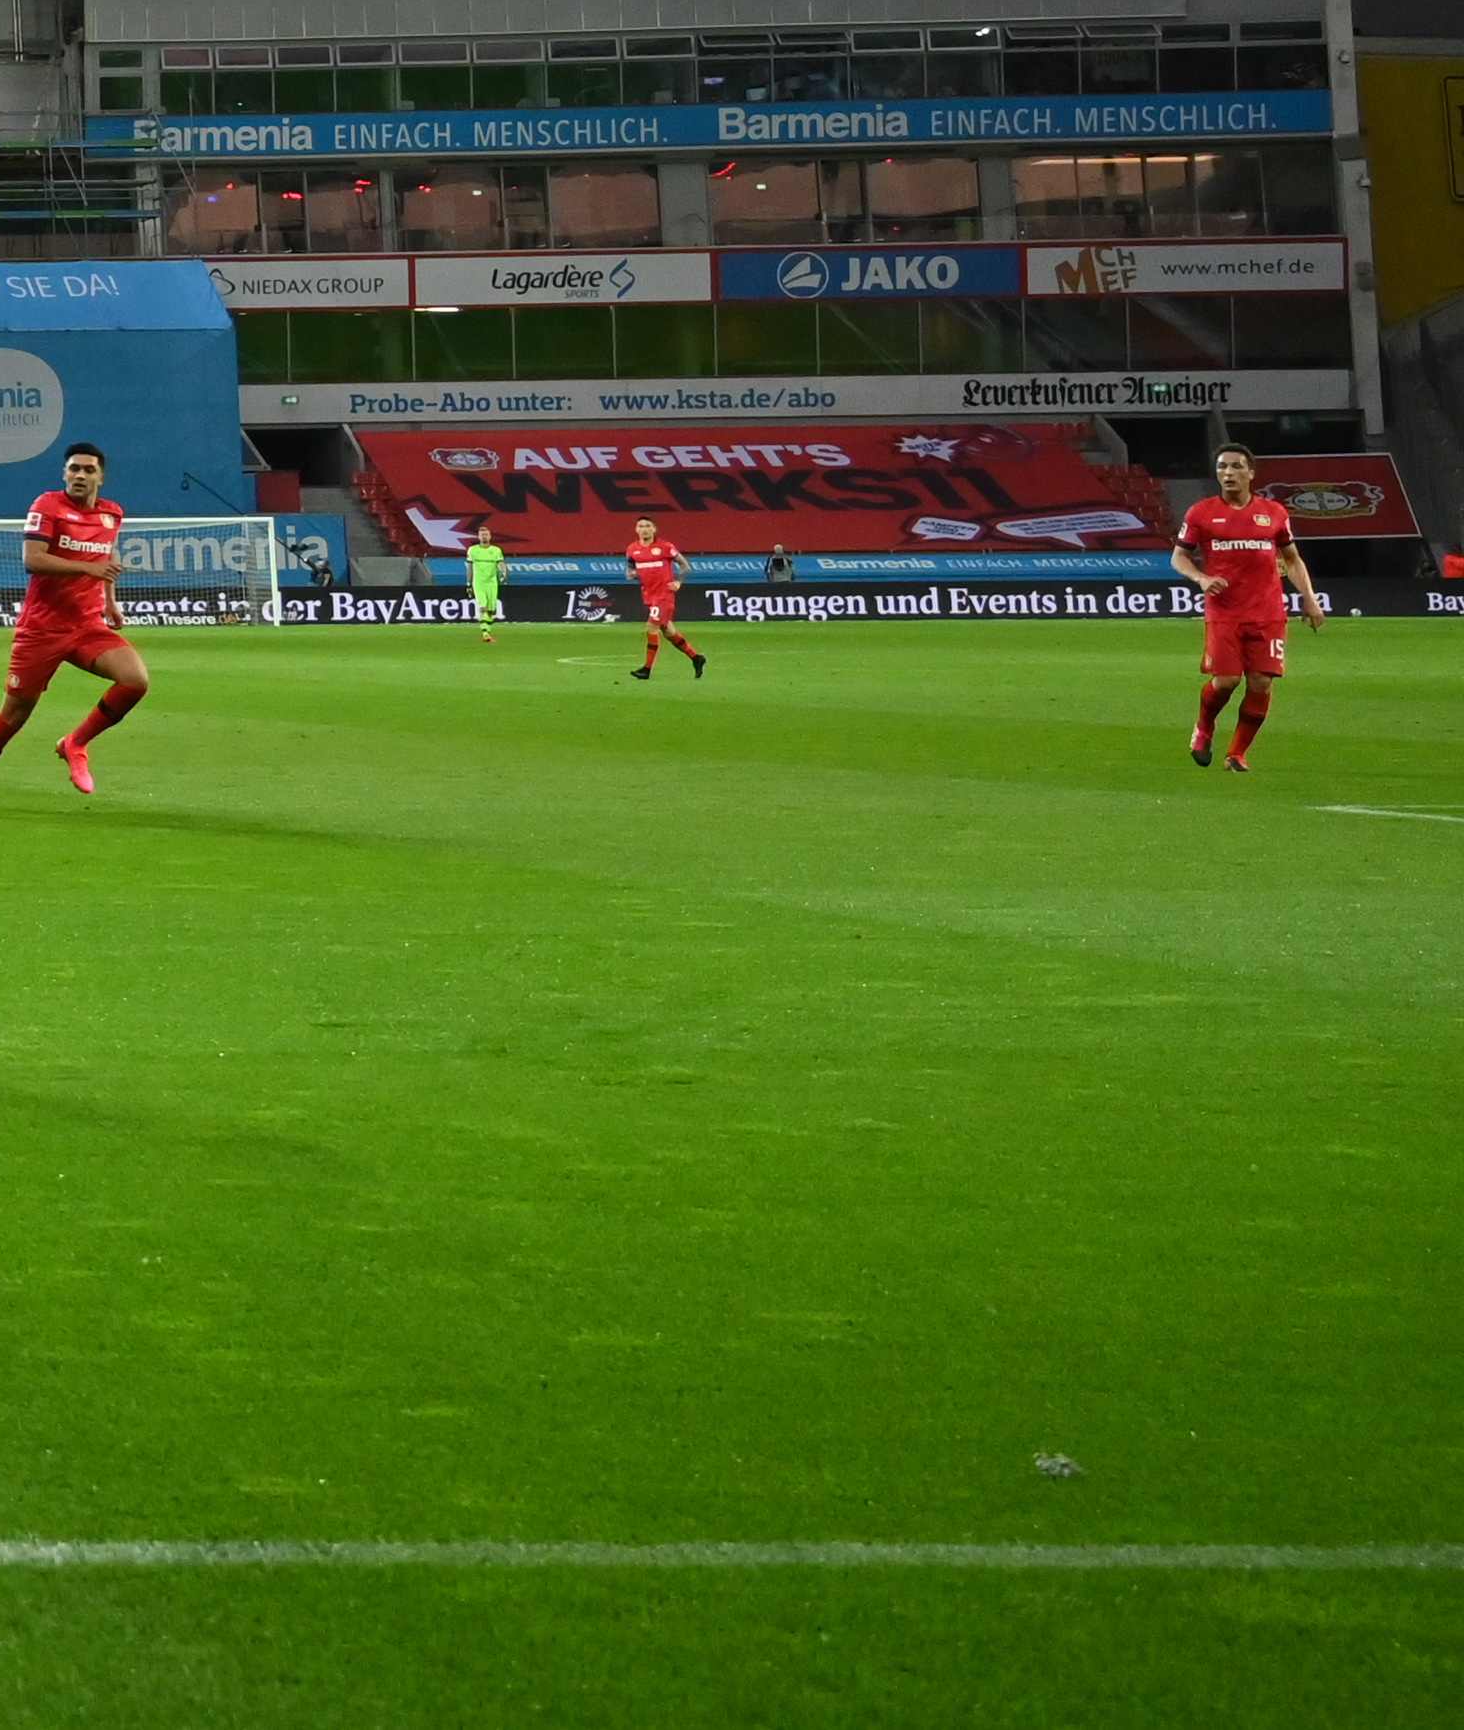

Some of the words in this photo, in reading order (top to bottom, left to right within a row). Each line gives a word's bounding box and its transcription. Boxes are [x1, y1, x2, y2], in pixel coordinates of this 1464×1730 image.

[718, 102, 908, 141] Barmenia
[931, 107, 1062, 137] EINFACH.
[1074, 104, 1278, 135] MENSCHLICH.
[132, 116, 313, 154] Barmenia
[334, 120, 461, 150] EINFACH.
[472, 116, 670, 147] MENSCHLICH.
[841, 256, 960, 291] JAKO
[1161, 258, 1315, 275] www.mchef.de
[7, 275, 57, 298] SIE
[63, 273, 120, 298] DA!
[242, 278, 310, 295] NIEDAX
[316, 276, 384, 294] GROUP
[492, 266, 604, 295] Lagardère
[565, 288, 600, 299] SPORTS
[350, 391, 492, 415] Probe-Abo
[497, 392, 573, 412] unter:
[599, 385, 836, 412] www.ksta.de/abo
[514, 446, 619, 470] AUF
[818, 558, 937, 570] Barmenia
[705, 589, 868, 622] Tagungen
[875, 587, 940, 615] und
[949, 587, 1057, 614] Events
[1064, 585, 1096, 613] in
[1106, 584, 1162, 613] der
